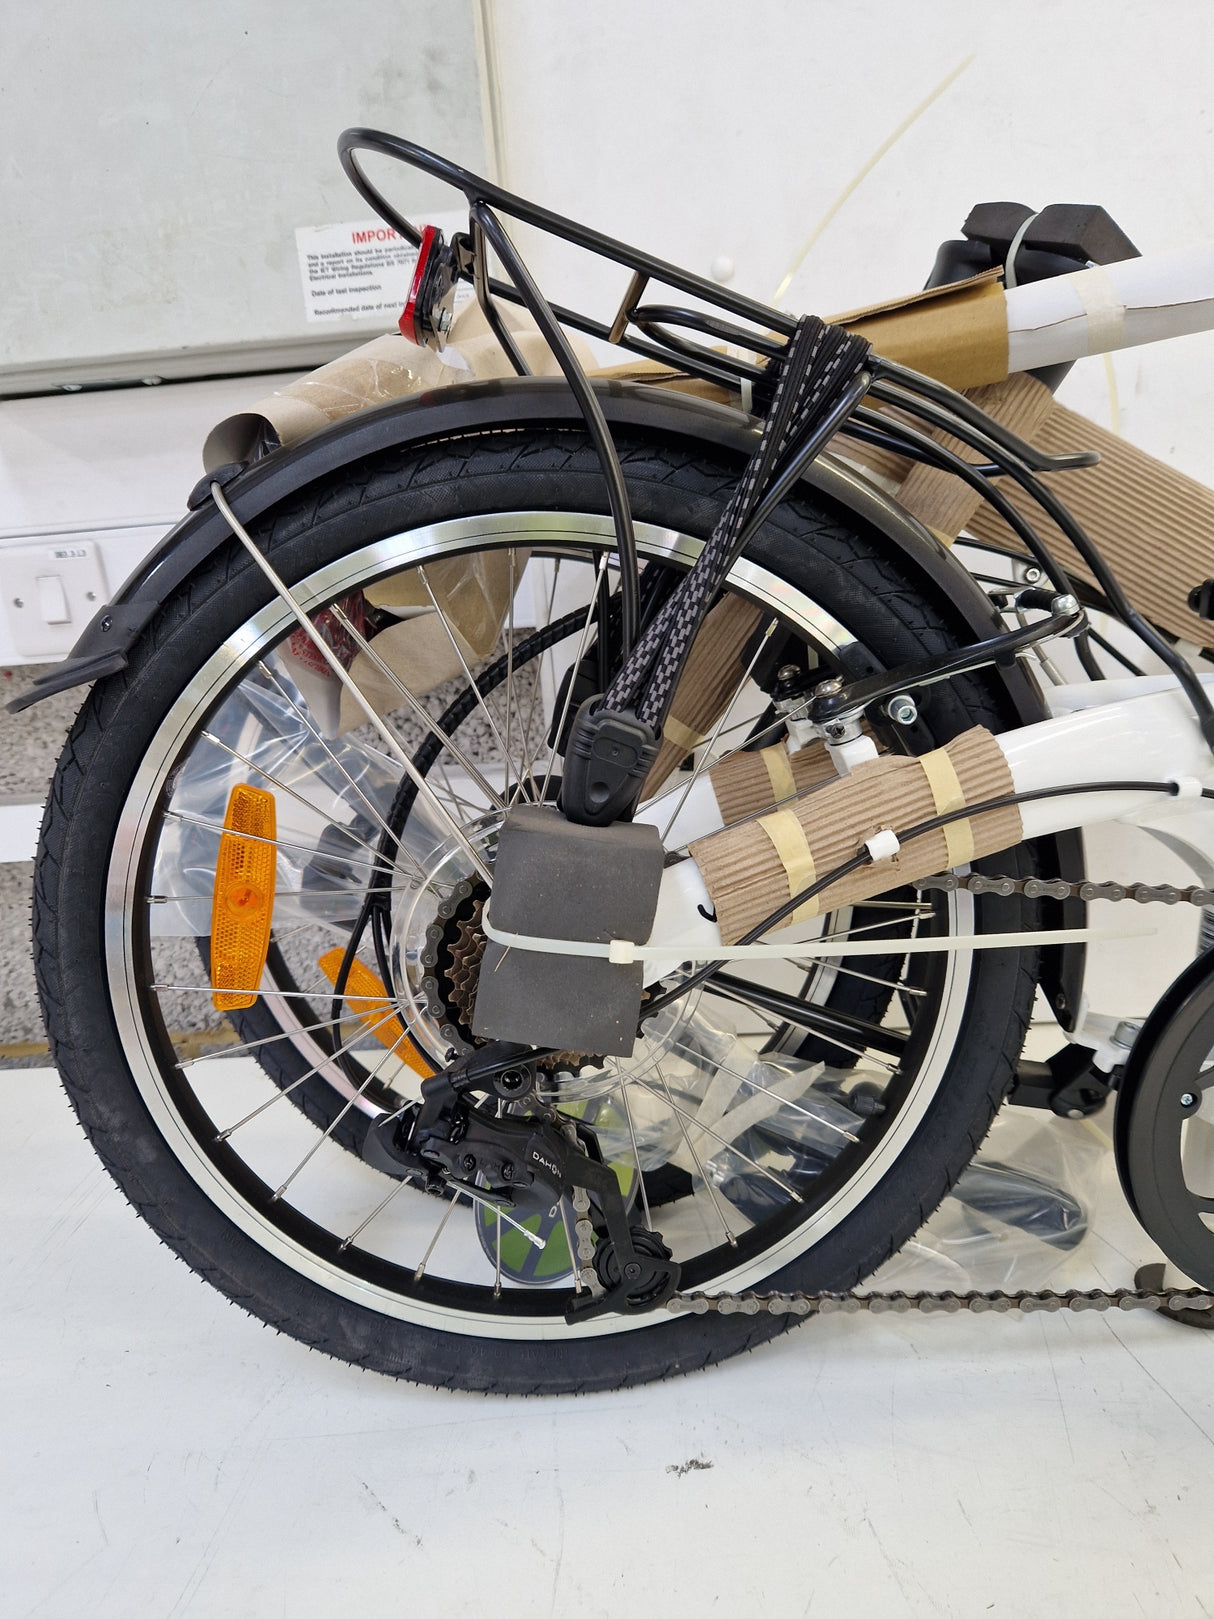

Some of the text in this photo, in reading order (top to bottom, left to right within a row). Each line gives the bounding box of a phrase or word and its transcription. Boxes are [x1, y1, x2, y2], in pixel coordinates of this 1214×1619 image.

[354, 248, 373, 256] should
[326, 259, 345, 267] report
[364, 254, 391, 262] condition
[351, 262, 384, 270] Regulations
[309, 274, 337, 282] Electrical
[336, 287, 347, 295] last
[314, 305, 360, 315] Recommended
[361, 304, 374, 312] date
[376, 302, 382, 310] of
[384, 301, 397, 309] next
[532, 1151, 562, 1178] DAHON
